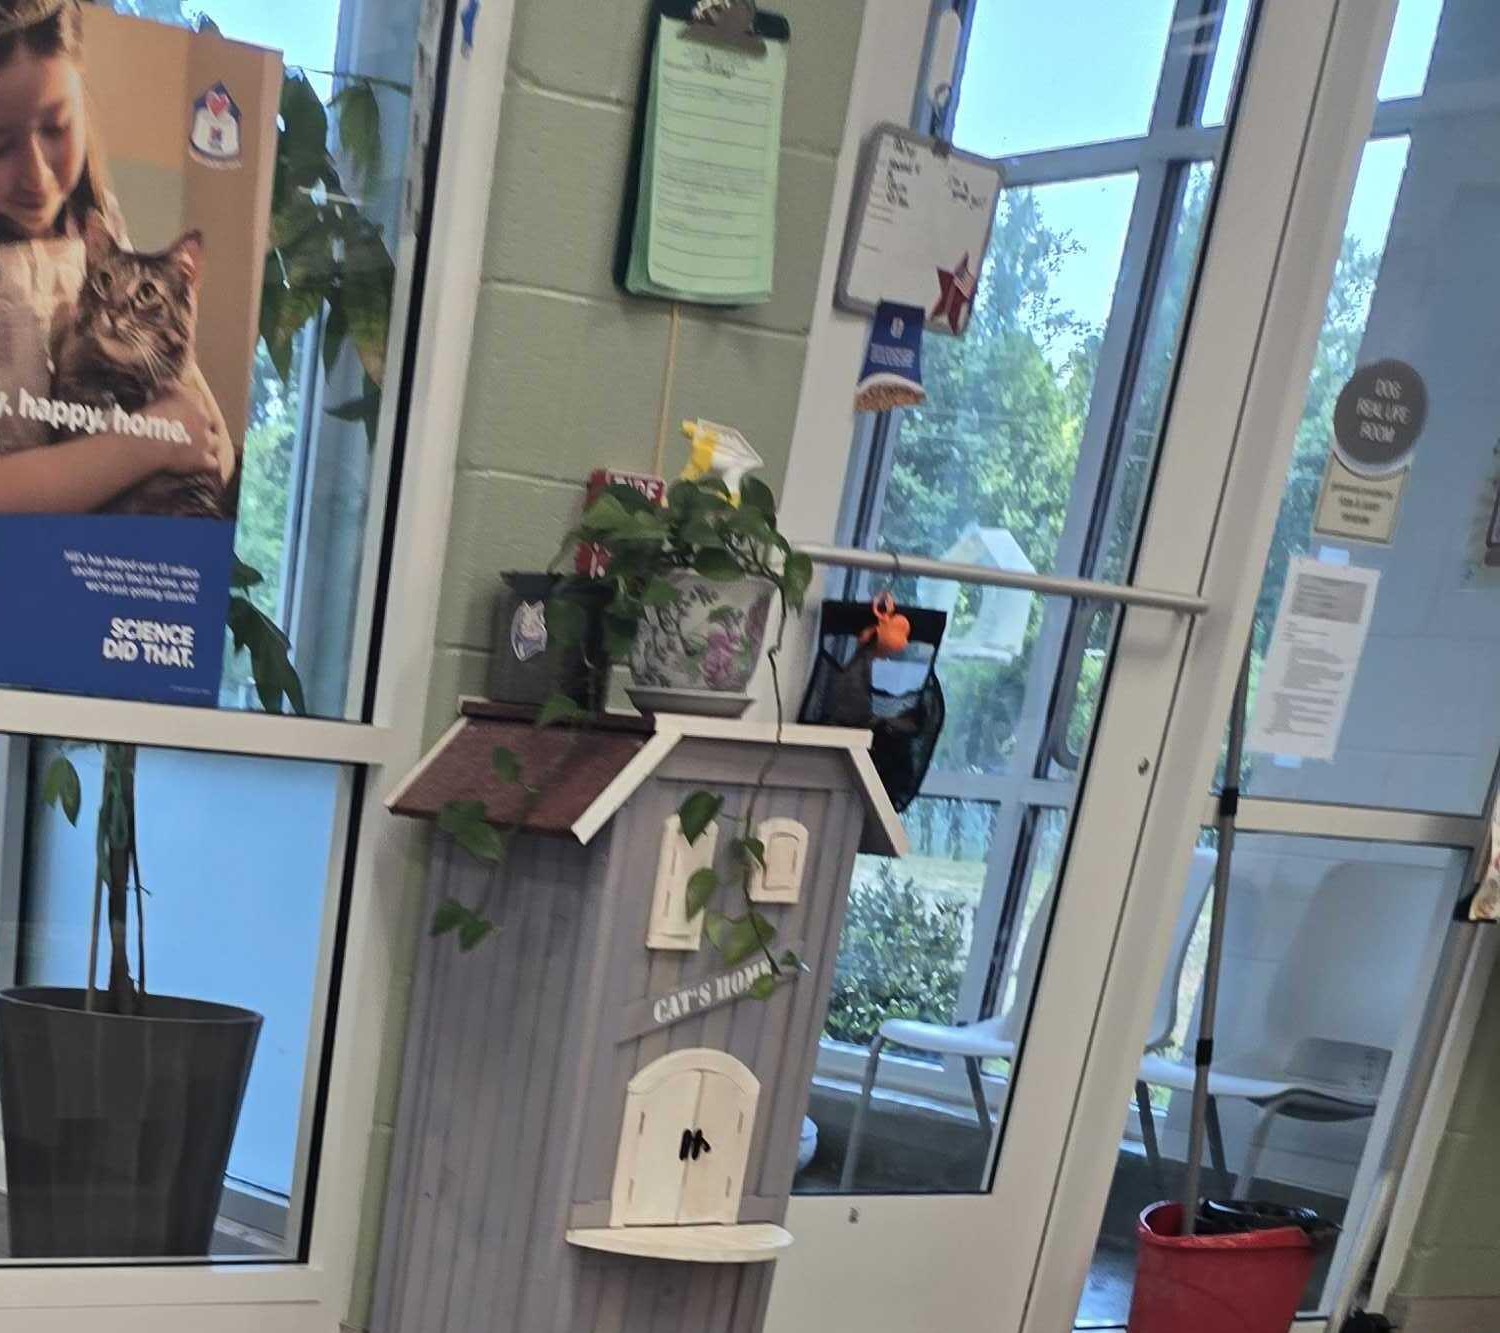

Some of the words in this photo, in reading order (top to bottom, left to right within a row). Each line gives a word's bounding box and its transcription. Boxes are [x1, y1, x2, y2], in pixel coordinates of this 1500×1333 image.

[1375, 378, 1402, 400] DOG
[18, 388, 107, 434] happy.
[111, 403, 192, 445] home.
[1360, 421, 1396, 443] ROOM
[110, 617, 195, 648] SCIENCE
[102, 637, 139, 662] DID
[140, 641, 195, 669] THAT.
[653, 982, 712, 1024] CAT'S
